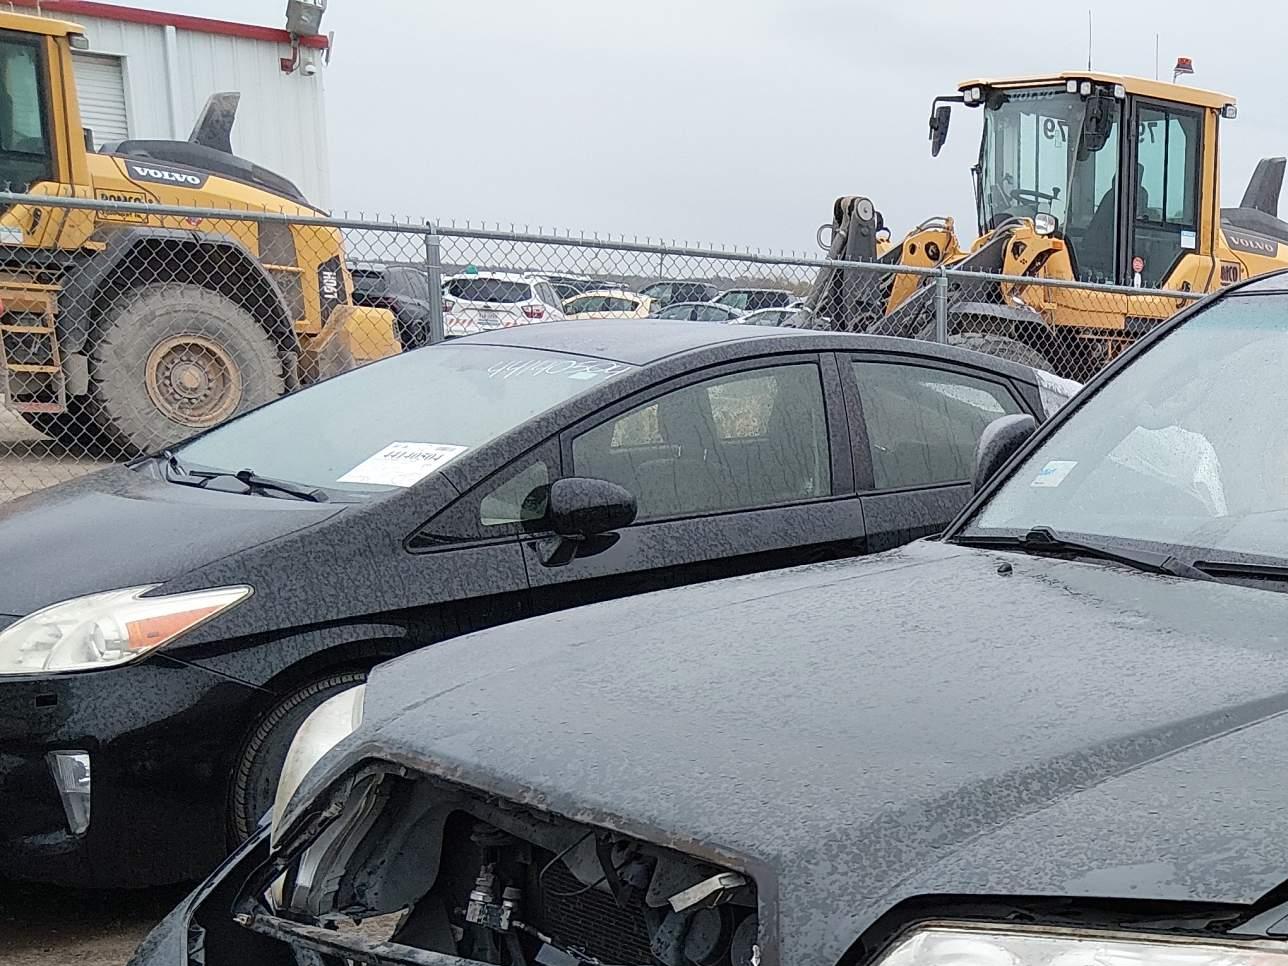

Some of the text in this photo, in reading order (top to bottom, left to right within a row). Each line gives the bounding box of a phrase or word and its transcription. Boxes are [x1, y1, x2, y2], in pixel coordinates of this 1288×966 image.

[132, 166, 201, 185] VOLVO
[1230, 236, 1274, 253] VOLVO
[322, 271, 338, 299] L90H
